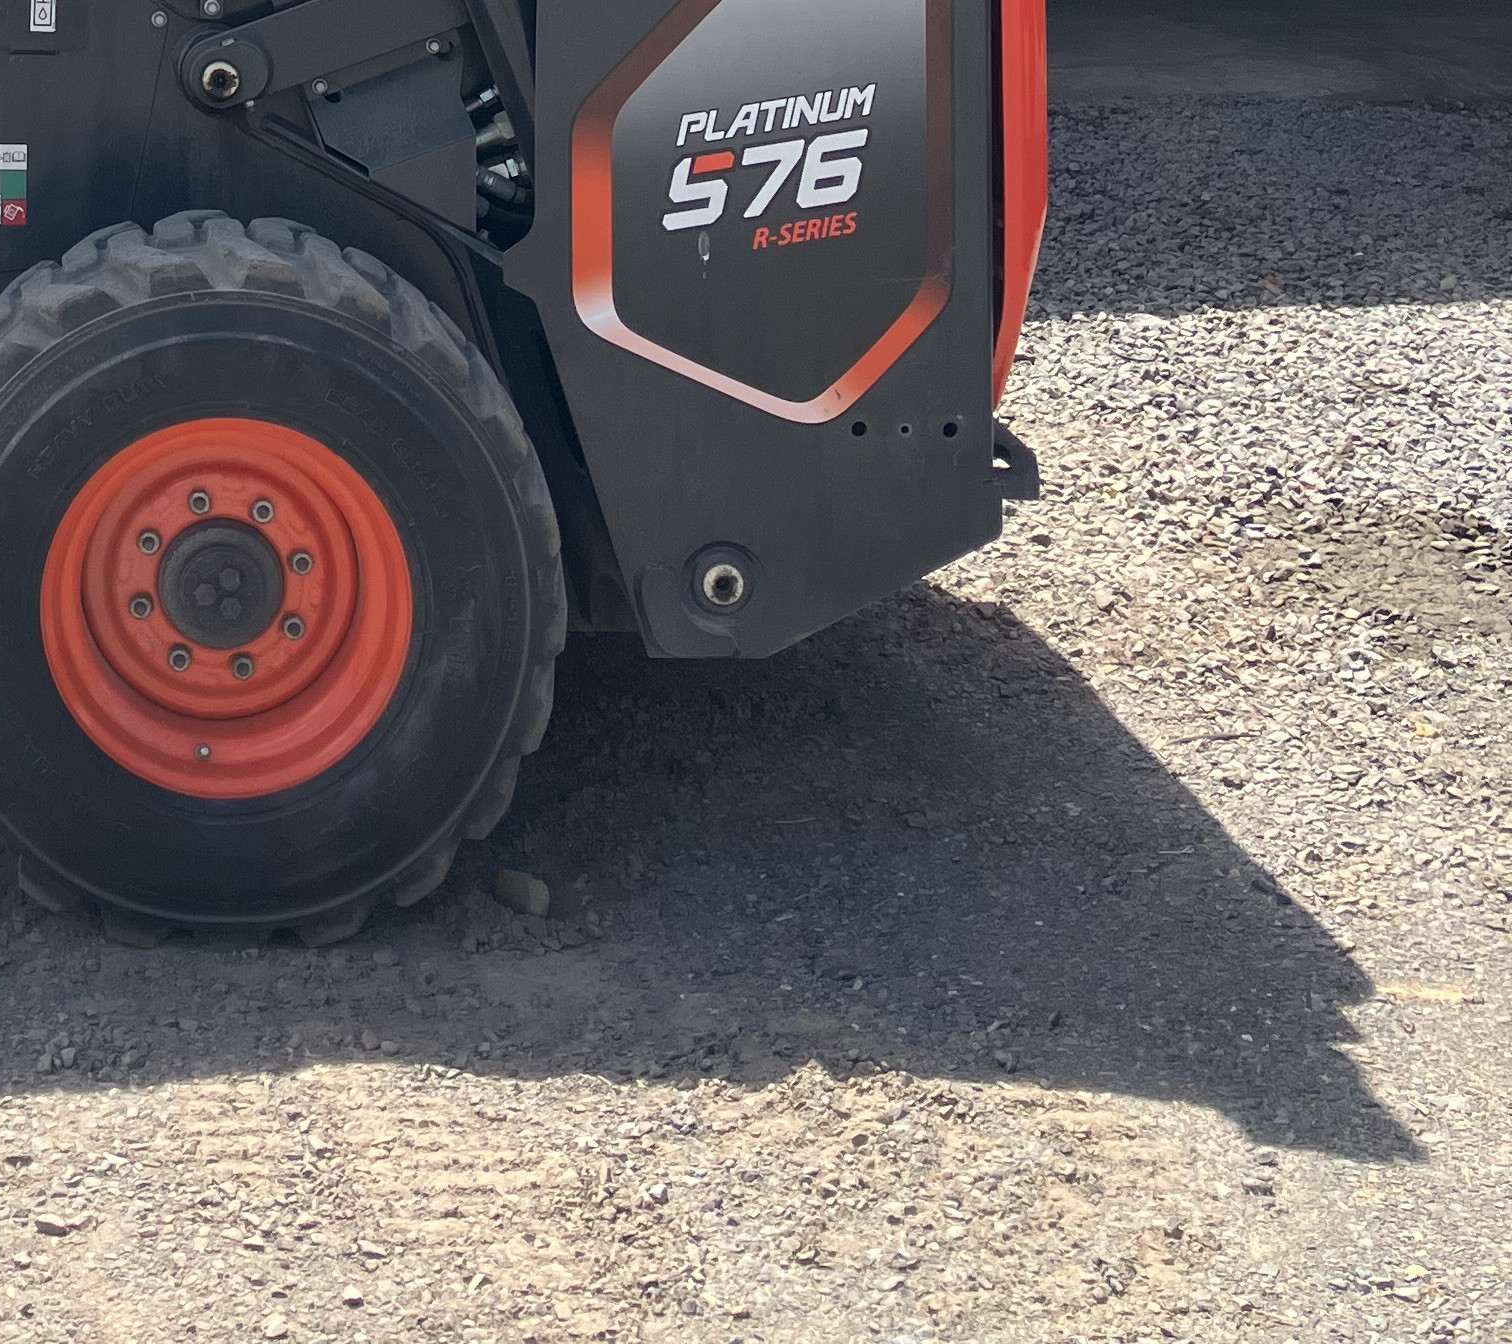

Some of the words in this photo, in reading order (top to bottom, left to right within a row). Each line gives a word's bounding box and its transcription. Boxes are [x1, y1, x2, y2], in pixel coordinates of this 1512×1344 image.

[676, 83, 877, 147] PLATINUM
[662, 128, 869, 231] S76
[753, 212, 858, 250] R-SERIES
